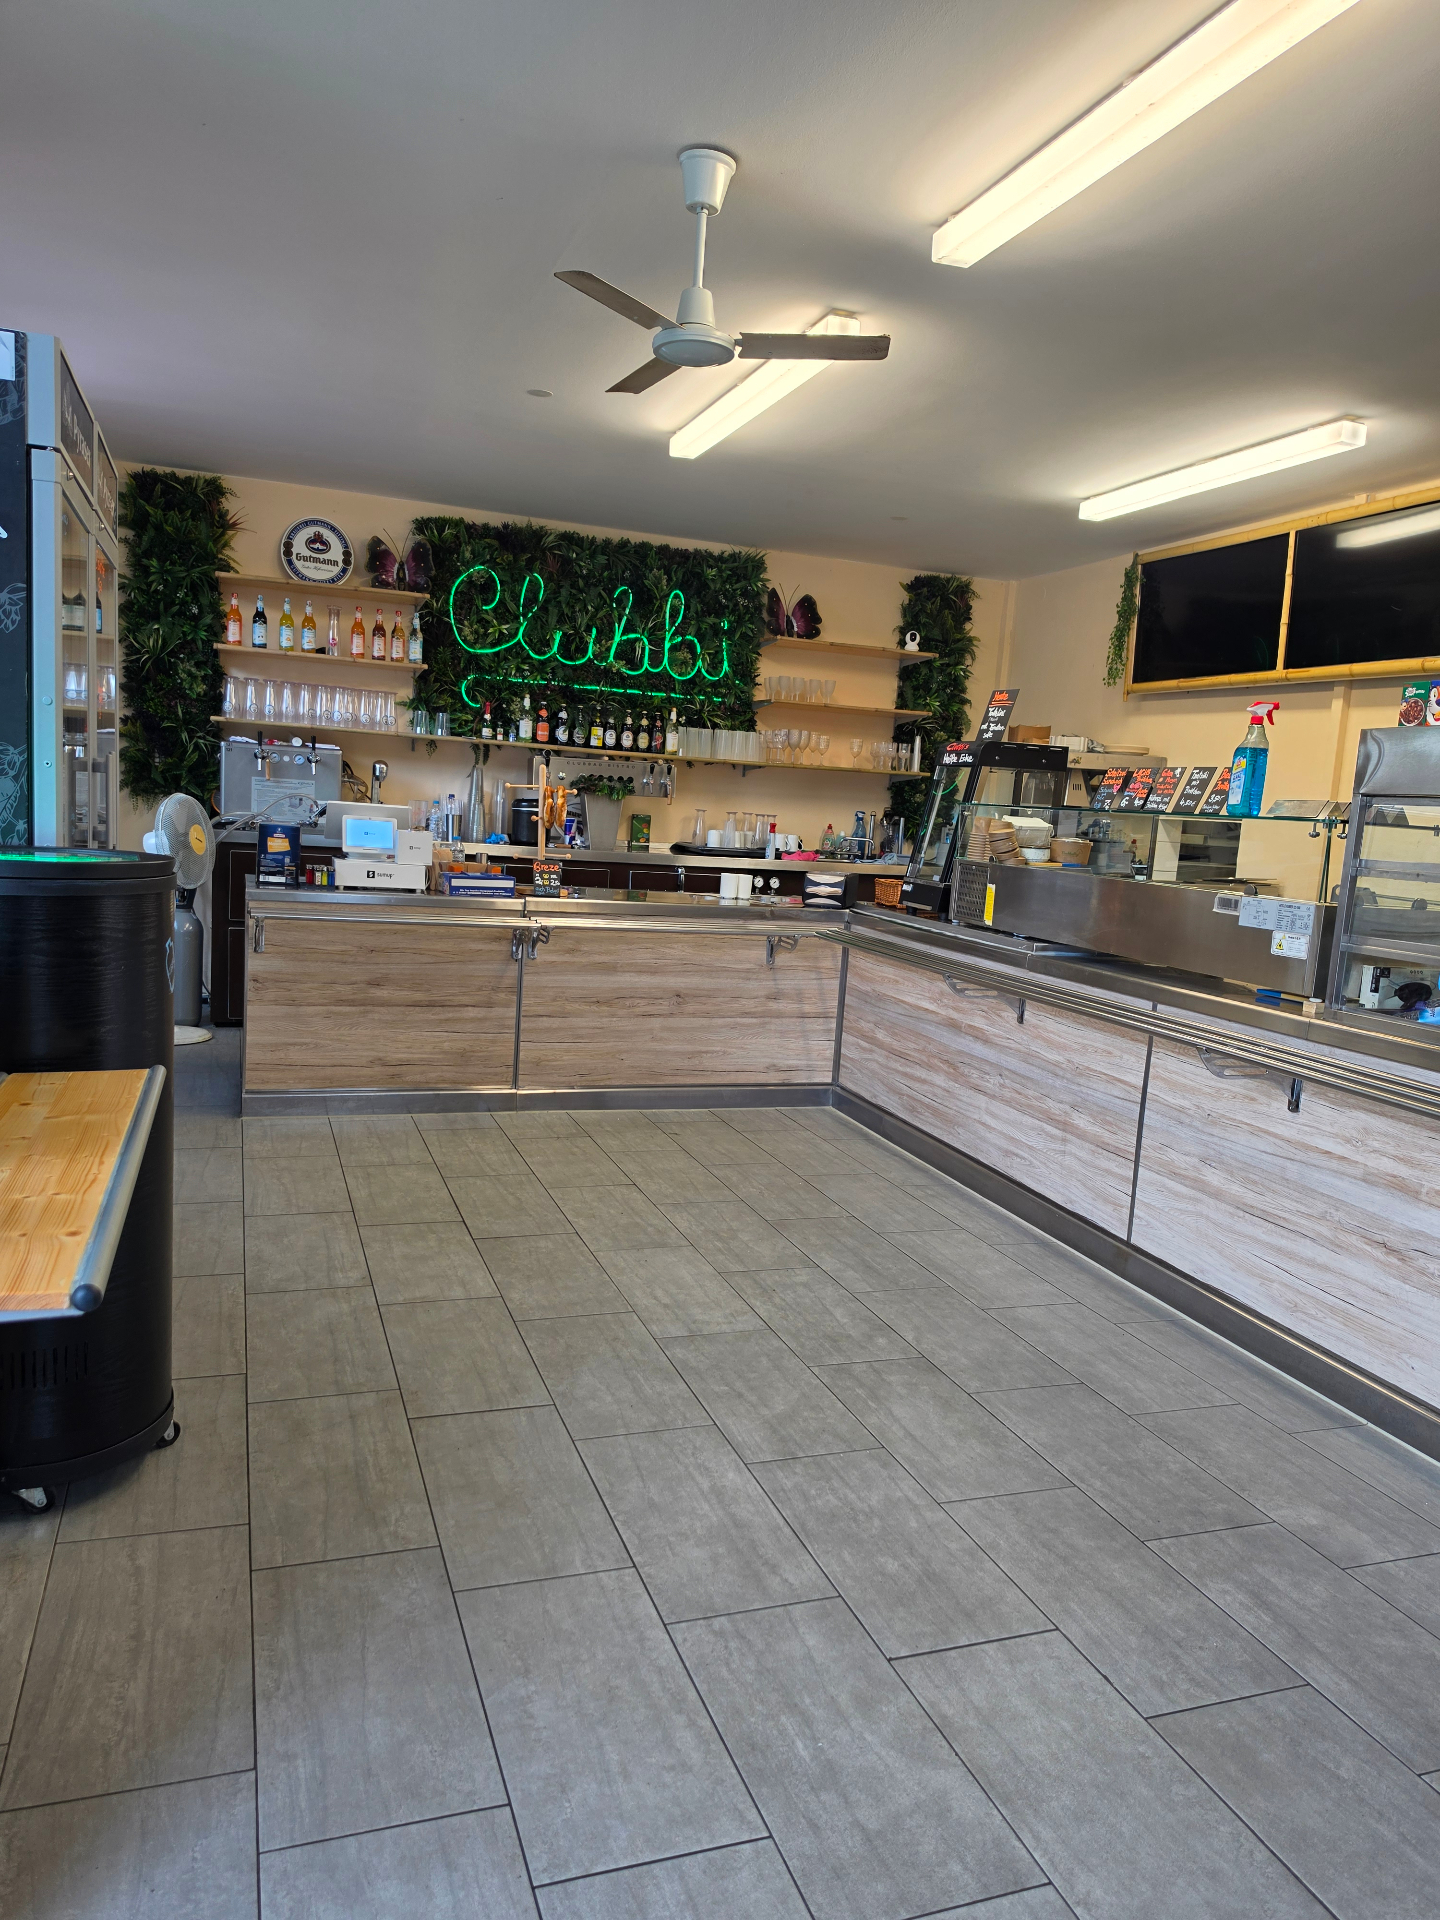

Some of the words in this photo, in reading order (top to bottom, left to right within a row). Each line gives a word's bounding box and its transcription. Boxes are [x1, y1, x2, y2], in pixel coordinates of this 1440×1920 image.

[307, 520, 331, 530] GUTMANN
[295, 552, 339, 567] Gutmann
[450, 565, 729, 681] Clubbi
[533, 861, 560, 872] Breze
